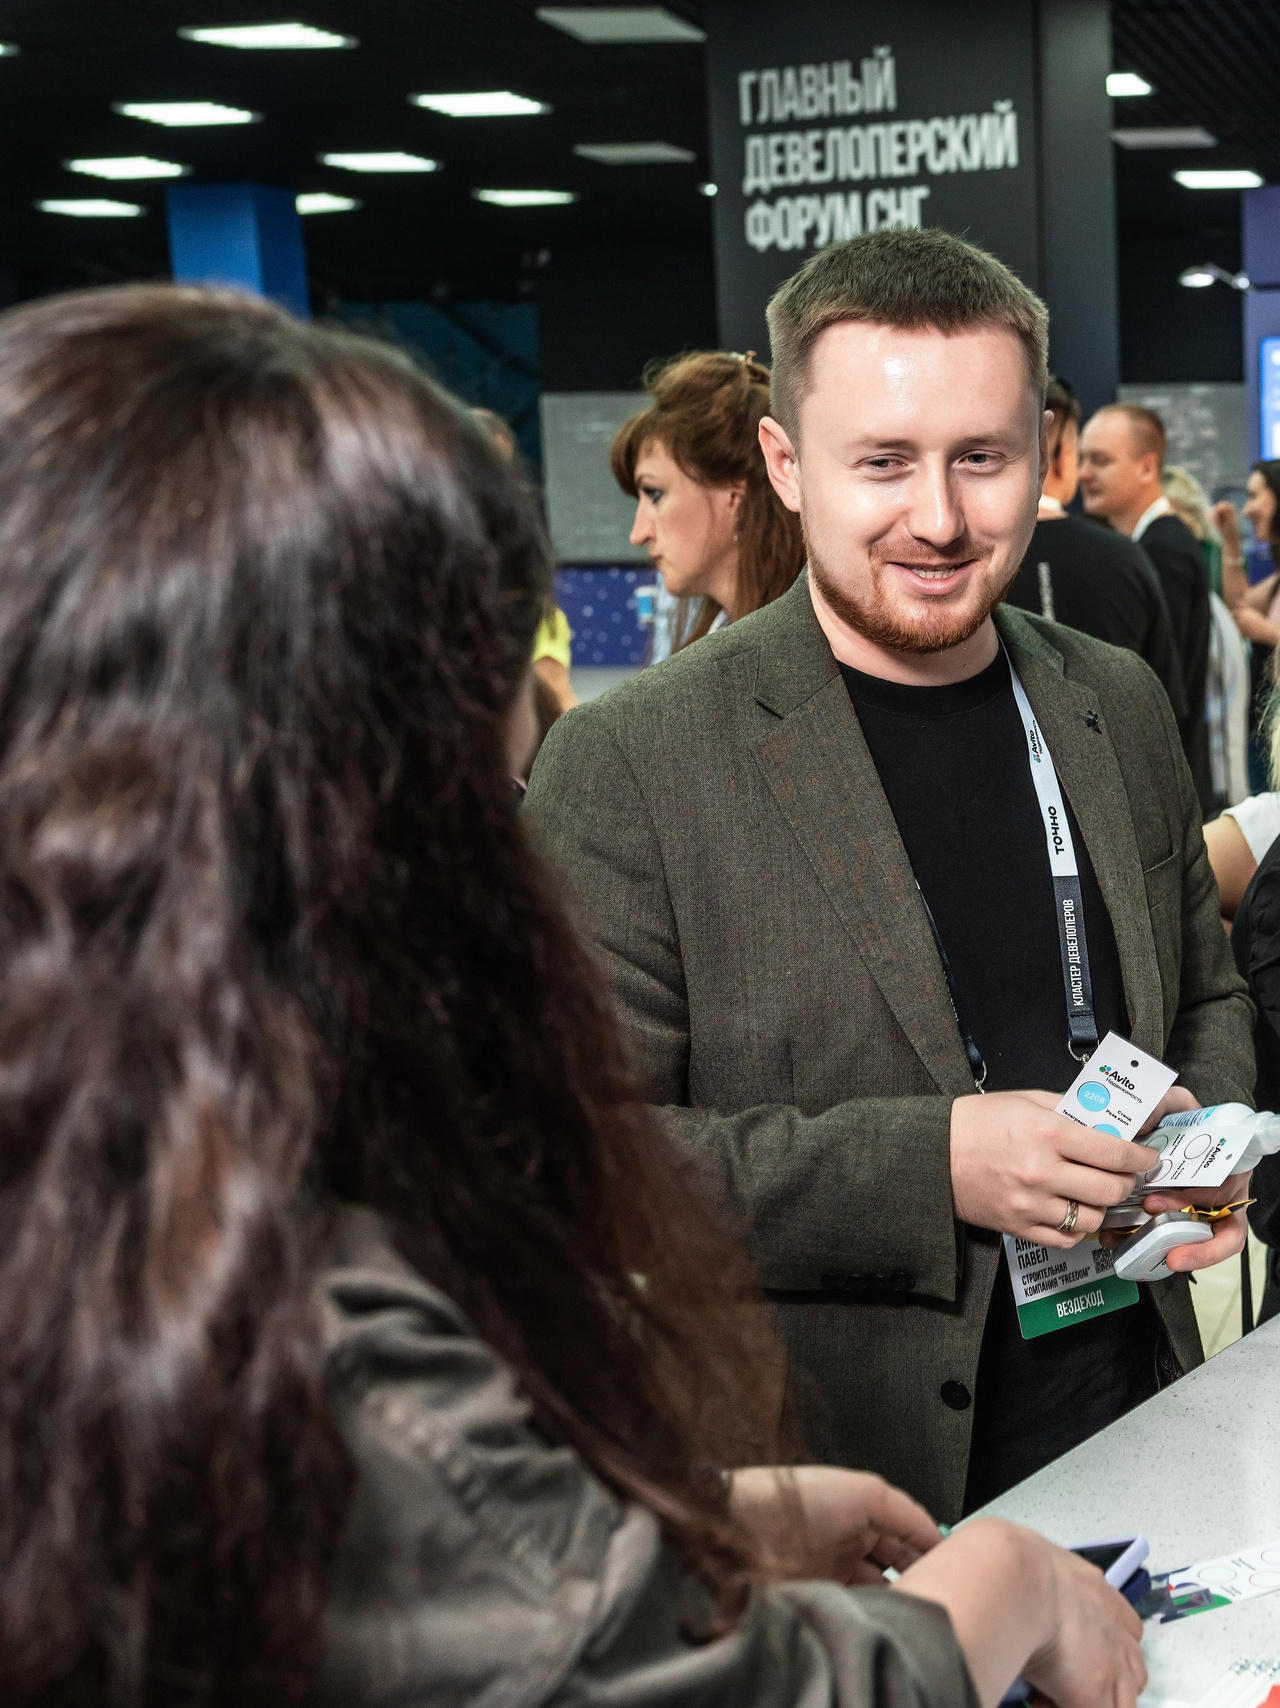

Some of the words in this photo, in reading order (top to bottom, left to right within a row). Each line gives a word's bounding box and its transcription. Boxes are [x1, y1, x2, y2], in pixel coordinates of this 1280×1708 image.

[738, 45, 897, 125] ГЛАВНЫЙ
[742, 100, 1018, 195] ДЕВЕЛОПЕРСКИЙ
[744, 190, 864, 251] ФОРУМ
[864, 184, 929, 236] СНГ
[1029, 730, 1039, 753] Avito
[1048, 805, 1065, 855] ТОЧНО
[1062, 899, 1081, 965] ДЕВЕЛОПЕРОВ
[1069, 965, 1084, 1006] КЛАСТЕР
[1108, 1070, 1136, 1091] Avito
[1203, 1146, 1221, 1169] Avito
[1015, 1236, 1040, 1254] АНИ
[1017, 1247, 1049, 1270] ПАВЕЛ
[1021, 1261, 1068, 1286] СТРОИТЕЛЬНАЯ
[1023, 1278, 1059, 1298] КОМПАНИЯ
[1058, 1266, 1091, 1286] "FREEDOM"
[1056, 1290, 1105, 1318] ВЕЗДЕХОД
